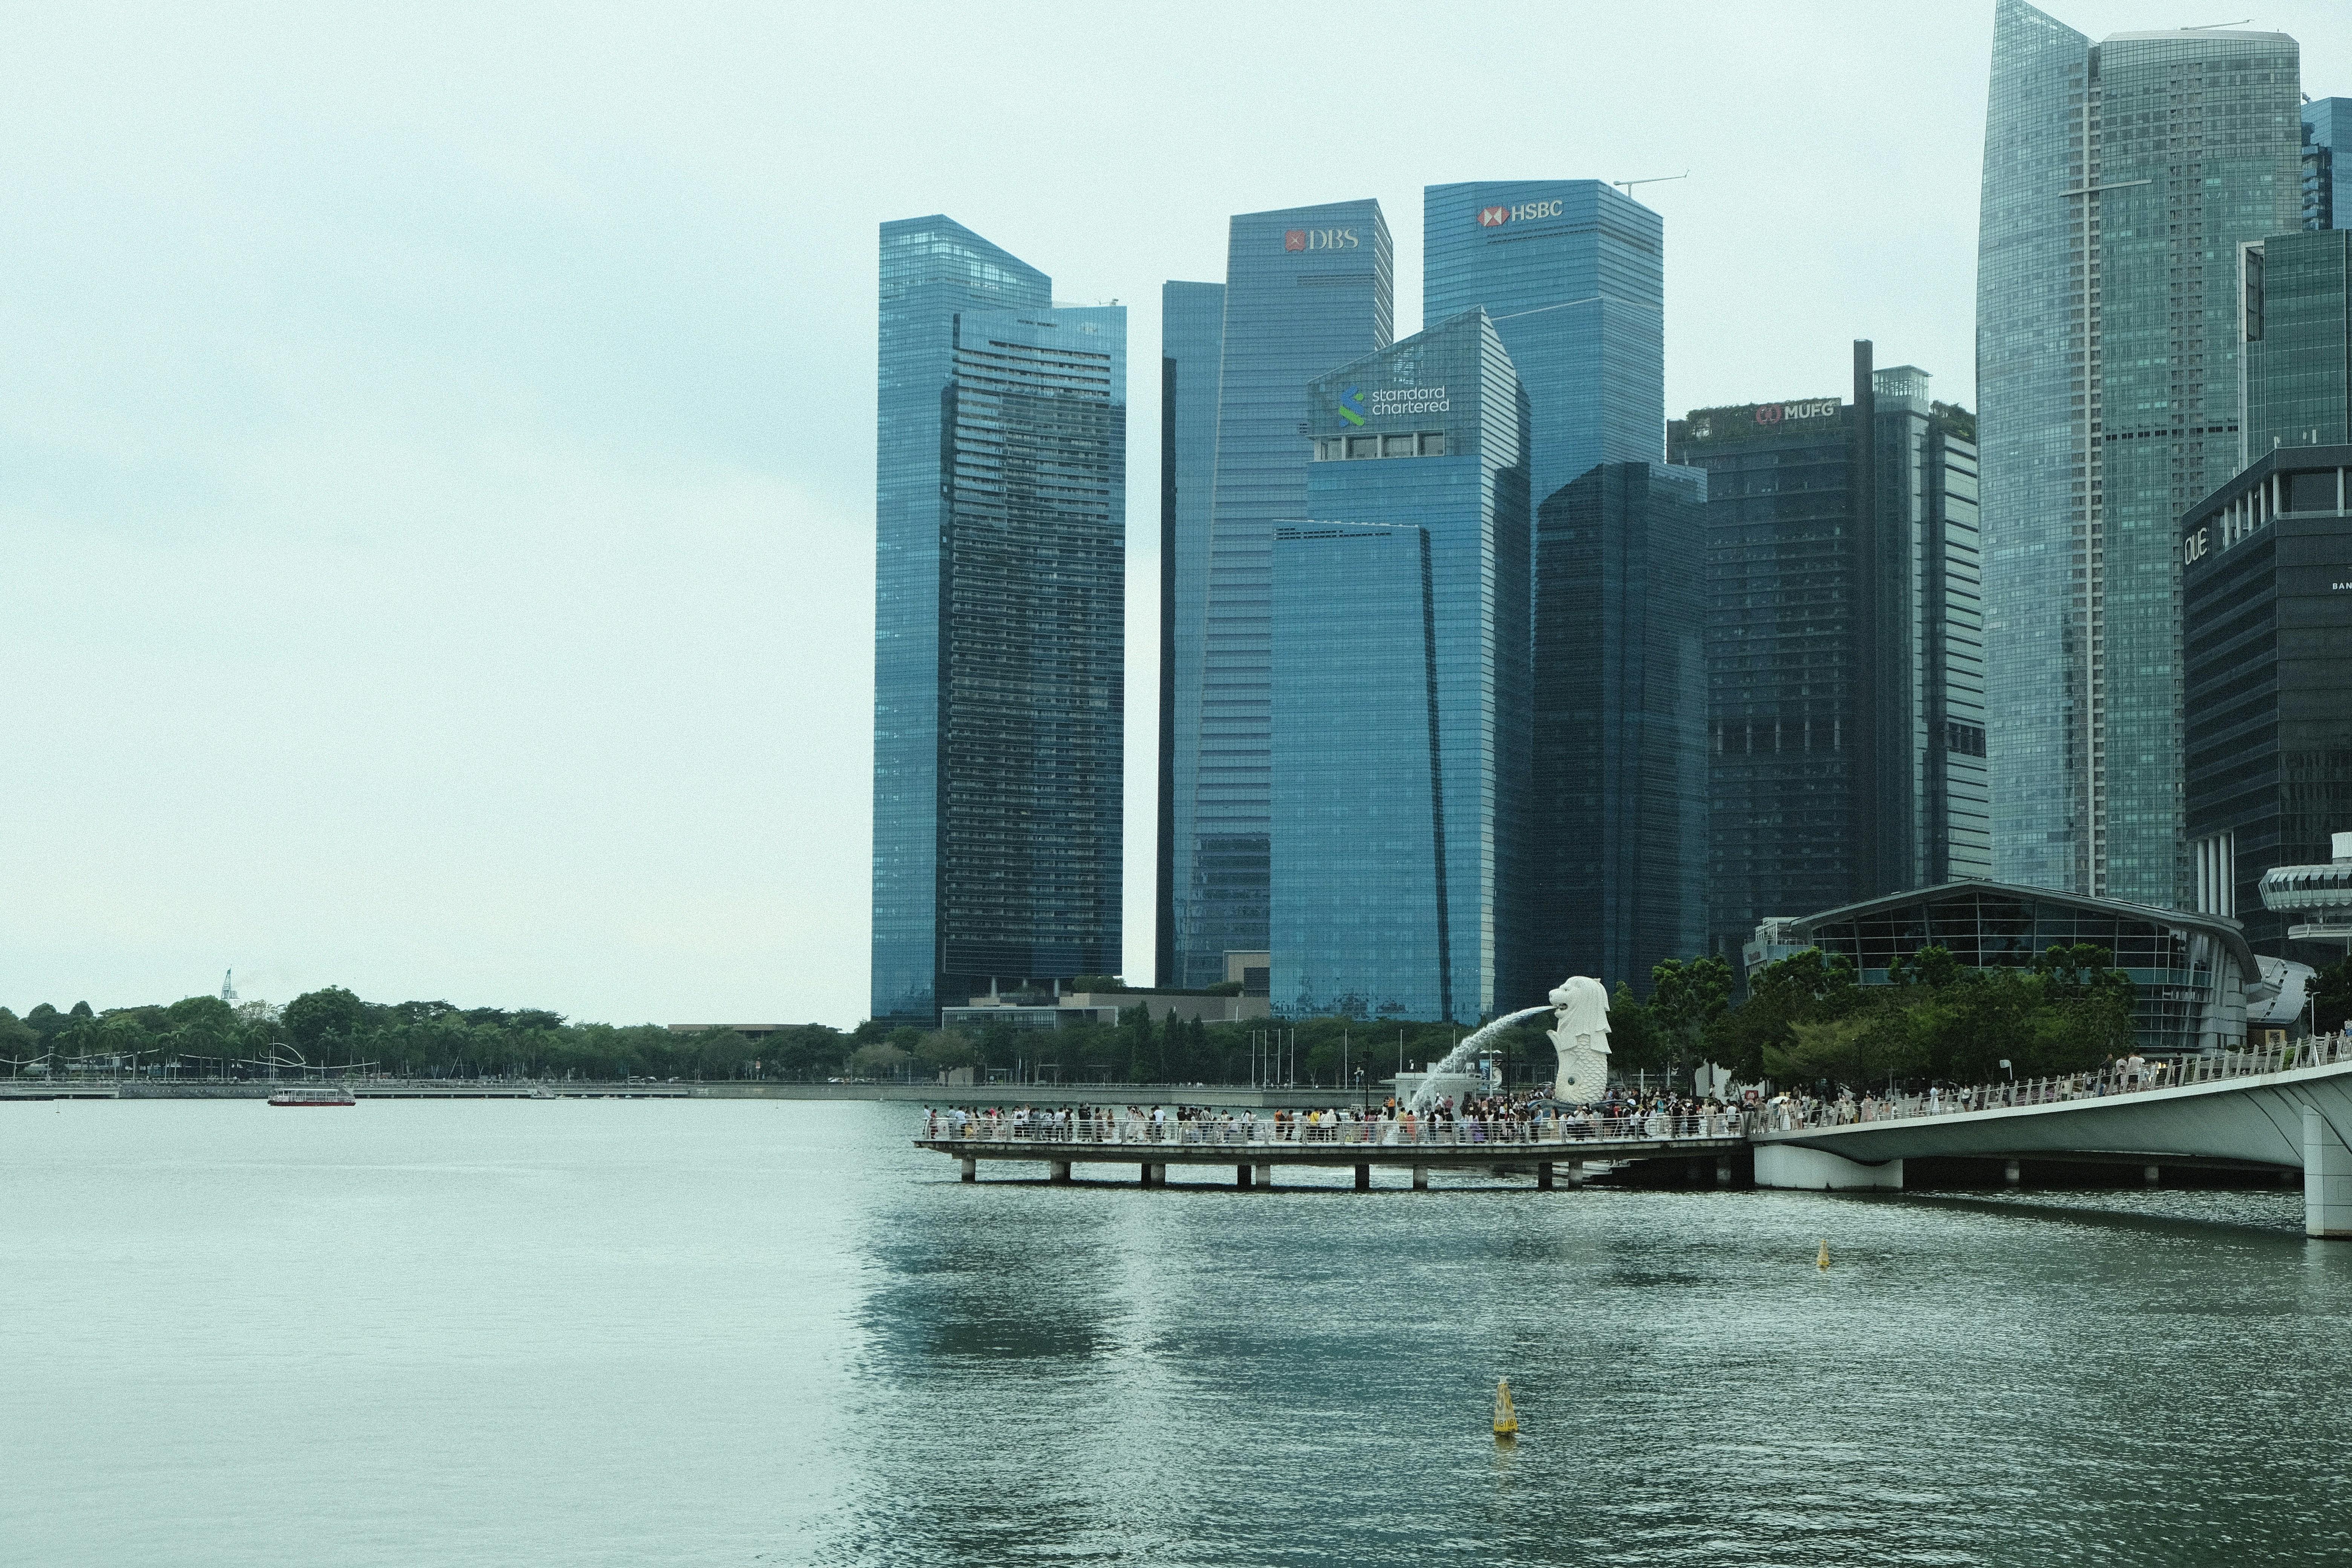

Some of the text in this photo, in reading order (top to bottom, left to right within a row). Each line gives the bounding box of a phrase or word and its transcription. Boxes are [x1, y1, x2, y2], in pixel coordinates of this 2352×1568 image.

[1511, 200, 1563, 222] HSBC
[1309, 229, 1359, 250] DBS
[1372, 385, 1445, 402] standard
[1372, 398, 1450, 415] chartered
[1785, 400, 1834, 420] MUFG
[2185, 528, 2208, 565] OUE
